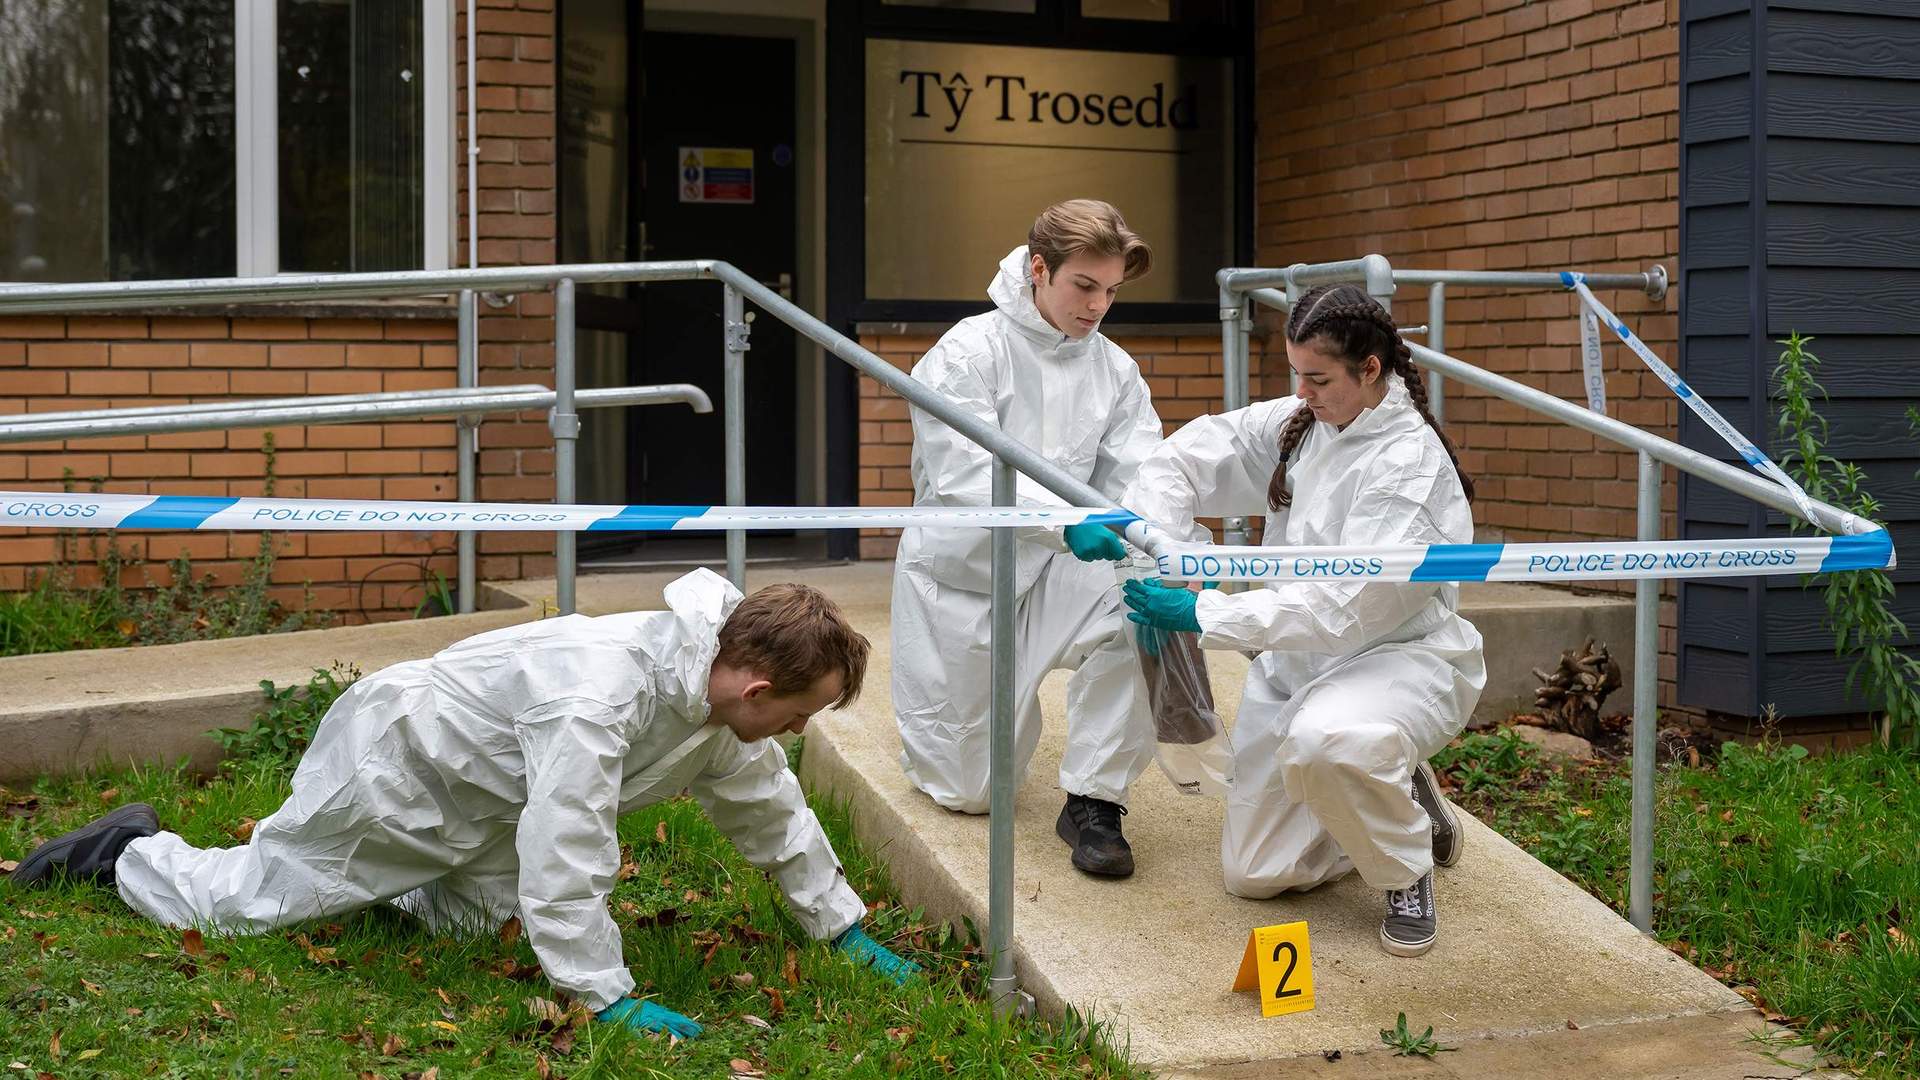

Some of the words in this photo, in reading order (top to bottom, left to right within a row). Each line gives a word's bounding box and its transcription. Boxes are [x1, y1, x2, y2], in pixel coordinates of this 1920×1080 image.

[900, 70, 973, 132] Tŷ
[986, 75, 1198, 130] Trosedd
[7, 502, 100, 518] CROSS
[252, 508, 354, 521] POLICE
[358, 510, 400, 522] DO
[406, 511, 466, 522] NOT
[472, 513, 568, 522] CROSS
[1181, 554, 1221, 577] DO
[1229, 556, 1283, 577] NOT
[1293, 557, 1385, 577] CROSS
[1528, 554, 1616, 573] POLICE
[1622, 553, 1658, 571] DO
[1663, 551, 1713, 570] NOT
[1717, 549, 1798, 568] CROSS
[1272, 941, 1302, 999] 2
